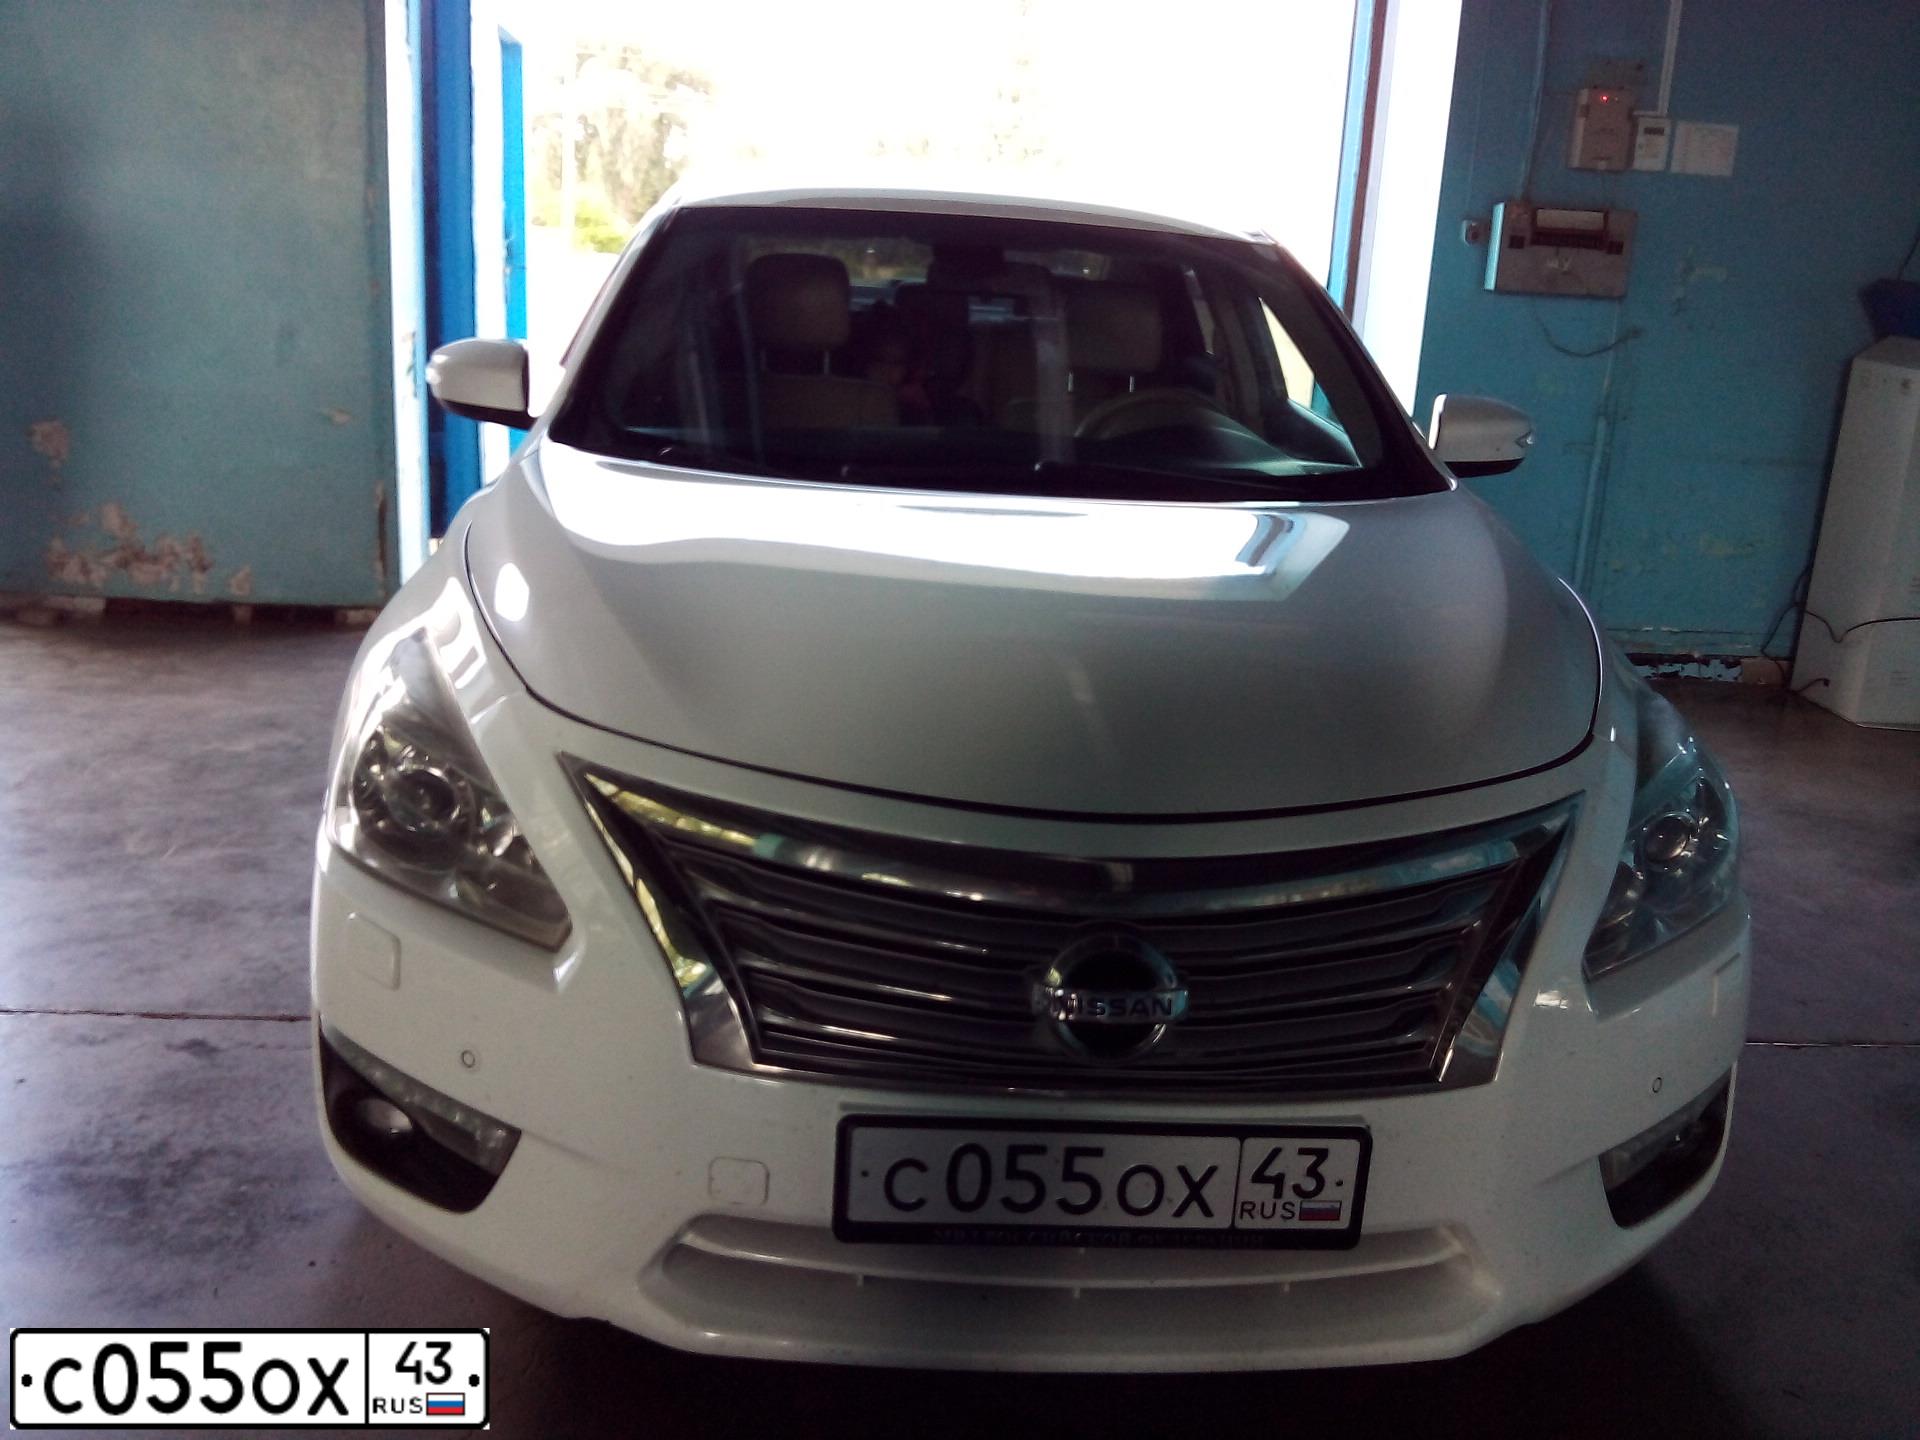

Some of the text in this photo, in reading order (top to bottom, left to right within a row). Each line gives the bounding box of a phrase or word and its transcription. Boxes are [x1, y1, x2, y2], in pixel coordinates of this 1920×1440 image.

[1053, 993, 1173, 1019] NISSAN
[1250, 1147, 1330, 1200] 43
[1239, 1200, 1297, 1221] RUS
